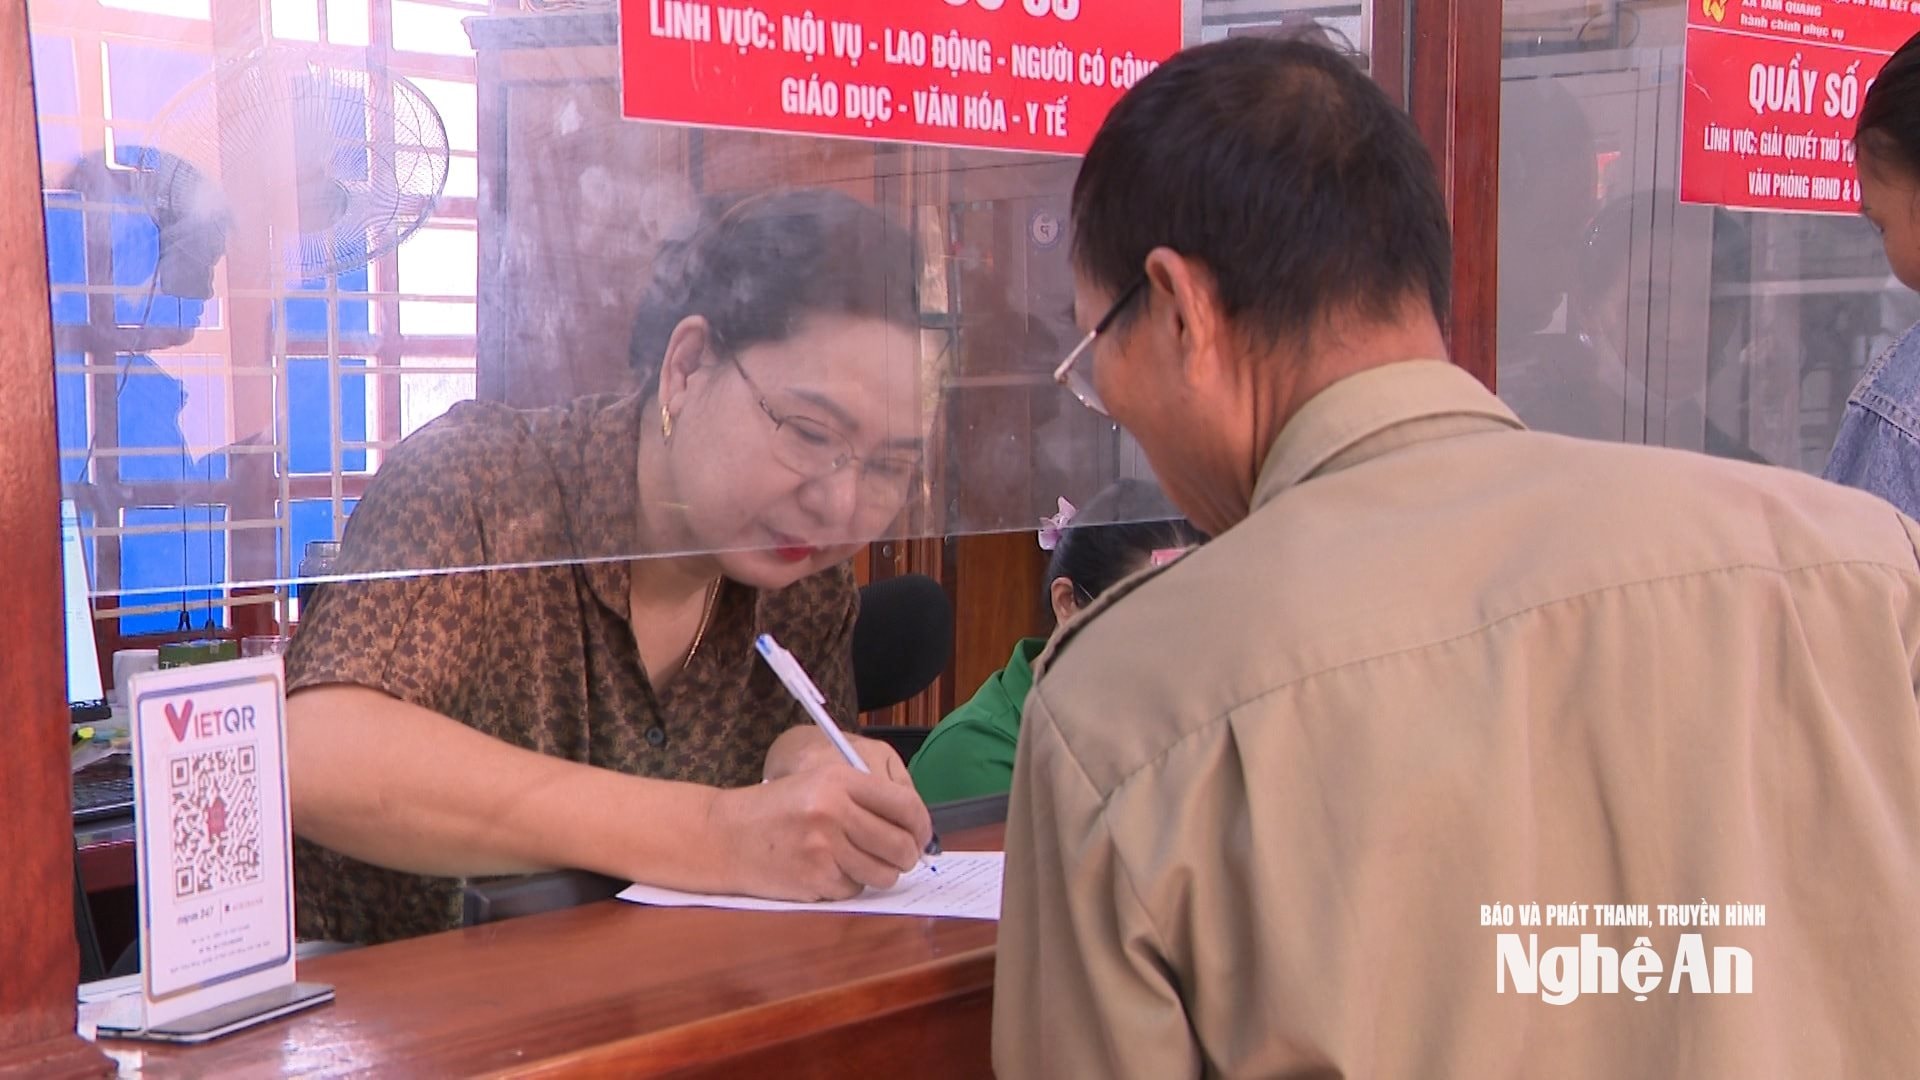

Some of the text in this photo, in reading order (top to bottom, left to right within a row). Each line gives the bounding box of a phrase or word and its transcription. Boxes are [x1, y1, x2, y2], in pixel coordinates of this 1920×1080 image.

[1785, 1, 1823, 17] QUANG
[718, 6, 776, 55] VỰC:
[782, 10, 825, 62] NỘI
[831, 21, 862, 67] VỤ
[884, 28, 926, 67] LAO
[931, 29, 992, 78] ĐỘNG
[1011, 42, 1073, 83] NGƯỜI
[1078, 47, 1105, 87] CÓ
[1831, 28, 1845, 41] vụ
[781, 72, 838, 117] GIÁO
[844, 83, 892, 128] DỤC
[913, 85, 958, 128] VĂN
[963, 90, 1007, 132] HÓA
[1025, 102, 1039, 134] Y
[1043, 95, 1068, 137] TẾ
[1748, 52, 1860, 119] QUẦY SỐ
[1704, 122, 1731, 152] LĨNH
[1732, 127, 1758, 159] VỰC:
[1759, 125, 1783, 157] GIẢI
[1784, 129, 1818, 161] QUYẾT
[1819, 131, 1841, 162] THỦ
[1748, 167, 1771, 196] VĂN
[1772, 169, 1810, 199] PHÒNG
[1811, 177, 1841, 201] HĐND
[1842, 179, 1851, 202] &
[164, 699, 256, 742] VIETQR
